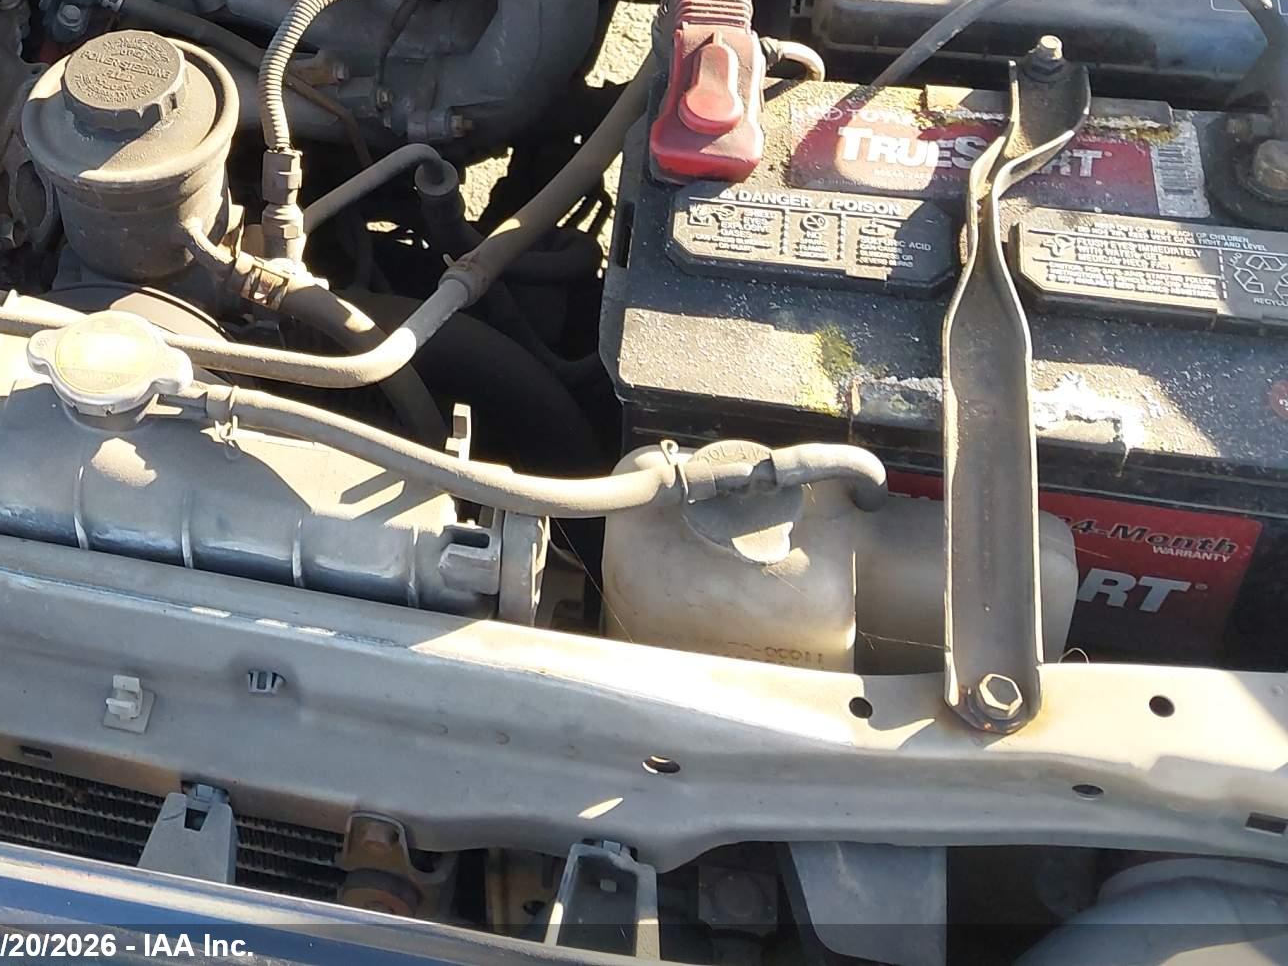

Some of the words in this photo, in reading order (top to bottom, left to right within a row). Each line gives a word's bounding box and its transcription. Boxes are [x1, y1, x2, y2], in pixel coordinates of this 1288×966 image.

[738, 190, 812, 208] DANGER
[831, 198, 903, 216] POISON
[908, 241, 931, 250] ACID
[1209, 233, 1249, 243] CHILDREN
[1137, 243, 1202, 258] IMMEDIATELY
[1242, 243, 1267, 251] LEVEL
[1061, 516, 1239, 554] 4-Month
[1153, 545, 1232, 563] WARRANTY
